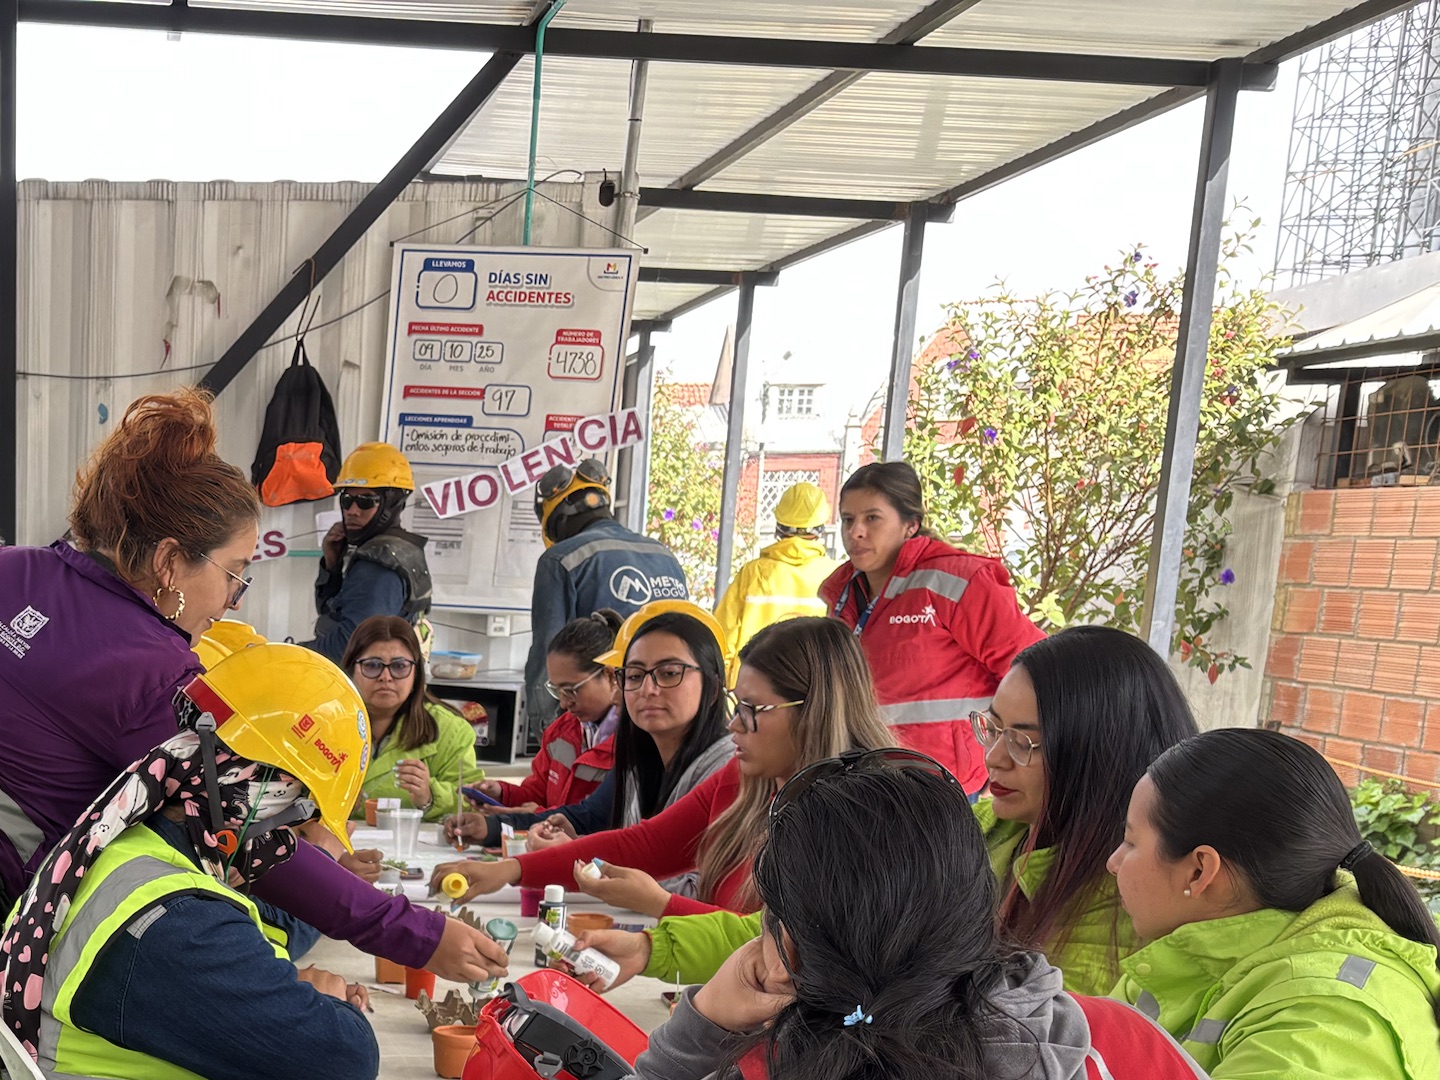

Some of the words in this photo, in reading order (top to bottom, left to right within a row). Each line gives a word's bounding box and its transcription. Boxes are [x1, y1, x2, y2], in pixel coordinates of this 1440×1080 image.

[431, 260, 467, 269] LLEVAMOS
[487, 269, 521, 285] DÍAS
[525, 272, 549, 286] SIN
[485, 290, 572, 305] ACCIDENTES
[557, 336, 600, 344] TRABAJADORES
[419, 343, 434, 359] 09
[449, 343, 464, 359] 10
[477, 345, 495, 359] 25
[419, 363, 432, 371] DÍA
[478, 365, 495, 373] AÑO
[556, 350, 597, 376] 4738
[491, 388, 516, 412] 97
[404, 415, 433, 423] LECCIONES
[410, 428, 448, 442] Omisión
[451, 429, 462, 442] de
[466, 442, 479, 453] de
[479, 443, 516, 461] trabajo
[424, 410, 643, 517] VIOLENCIA
